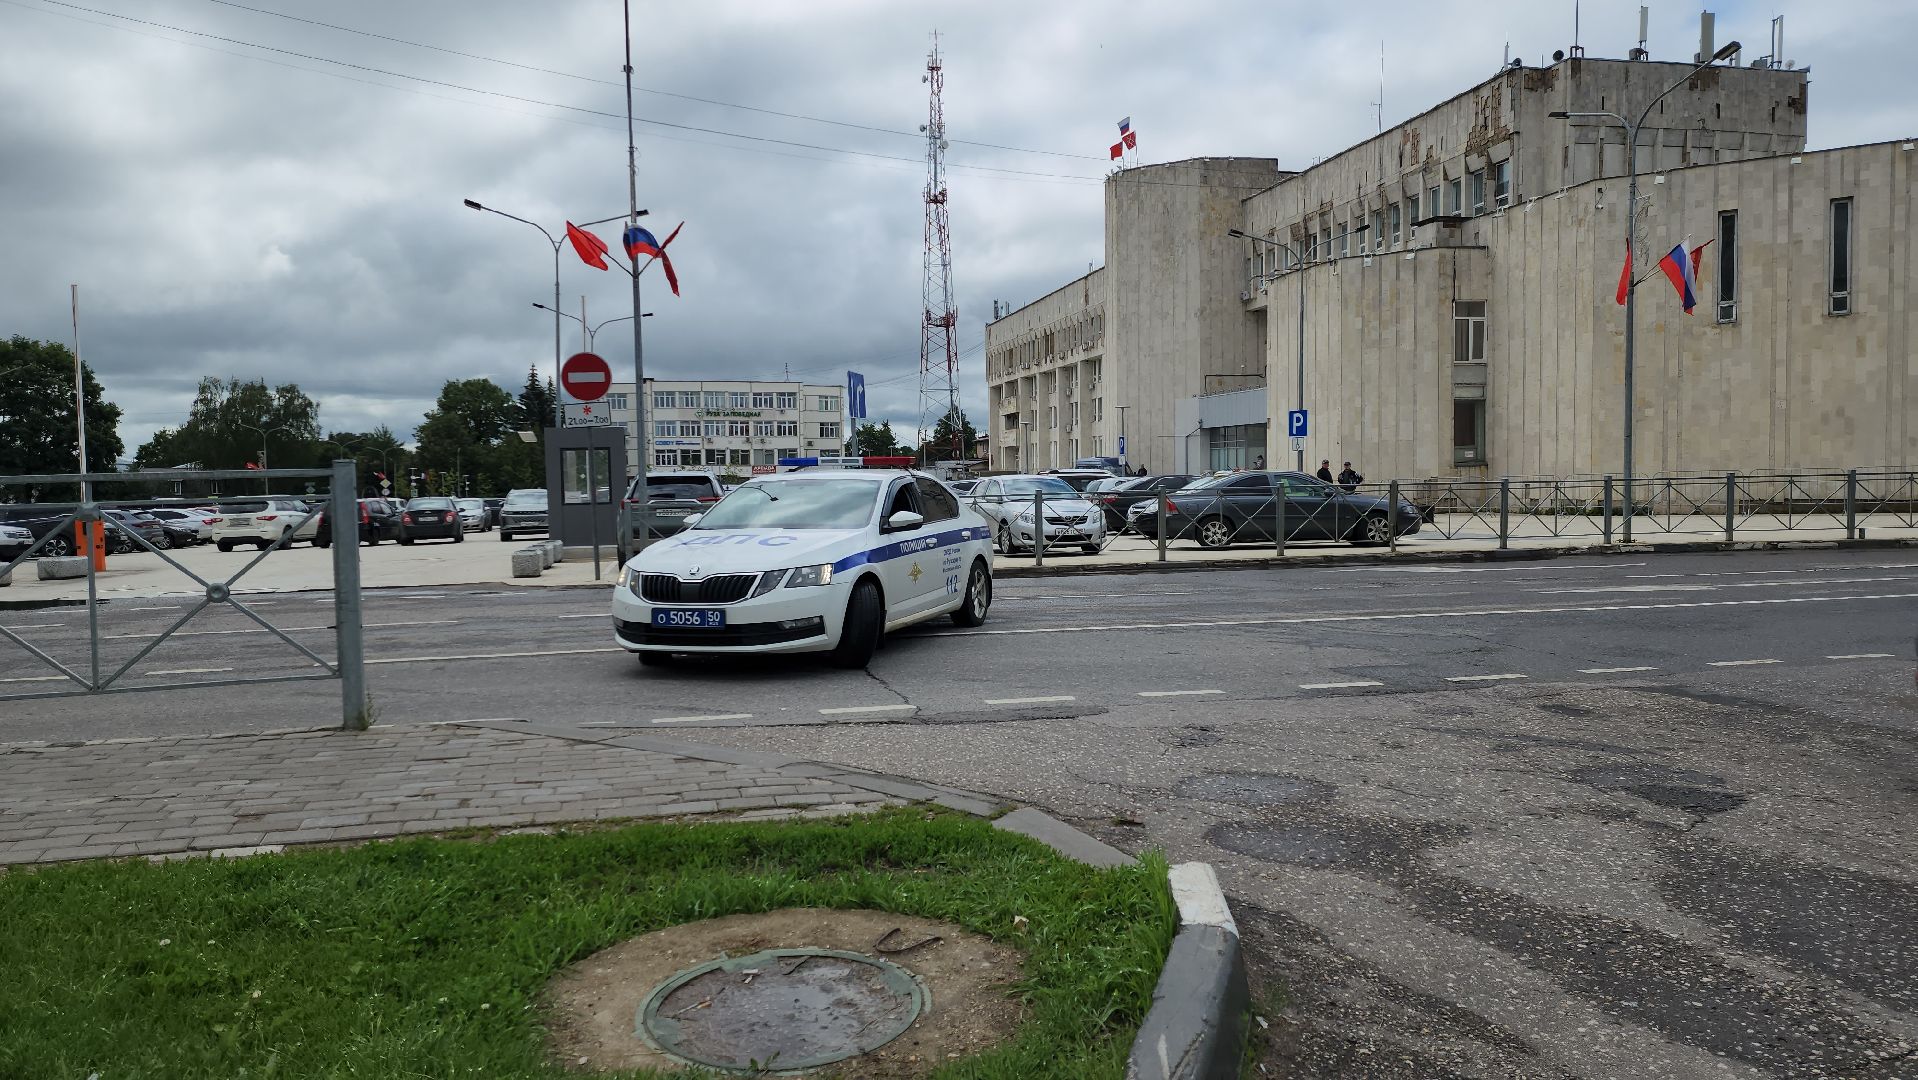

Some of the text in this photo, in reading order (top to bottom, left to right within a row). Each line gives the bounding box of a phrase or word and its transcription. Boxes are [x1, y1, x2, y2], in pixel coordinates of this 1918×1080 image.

[1293, 412, 1304, 435] P
[669, 533, 798, 549] ДПС
[946, 574, 958, 595] 112
[670, 611, 701, 625] 5056
[707, 611, 720, 622] 50
